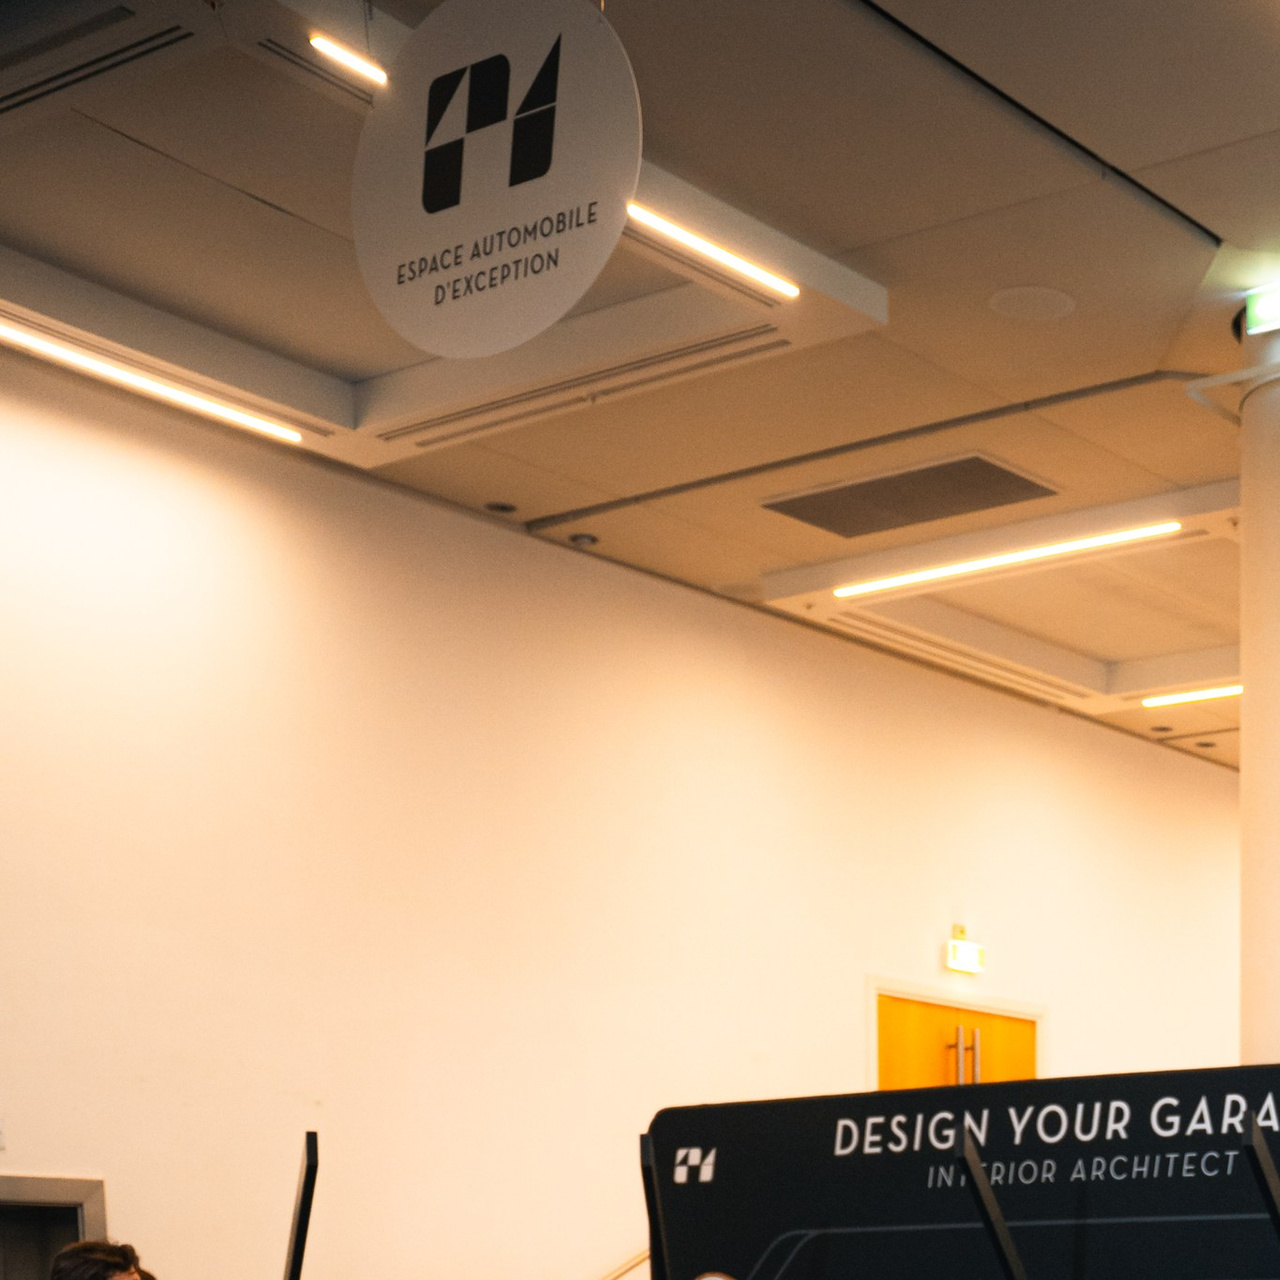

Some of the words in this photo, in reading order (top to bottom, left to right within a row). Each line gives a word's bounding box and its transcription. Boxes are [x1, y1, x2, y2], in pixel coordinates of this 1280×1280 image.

[397, 245, 464, 285] ESPACE
[470, 201, 599, 261] AUTOMOBILE
[434, 248, 561, 306] D'EXCEPTION
[833, 1108, 990, 1157] DESIGN
[1008, 1100, 1131, 1146] YOUR
[927, 1158, 1058, 1189] INRIOR
[1070, 1151, 1240, 1184] ARCHITECT
